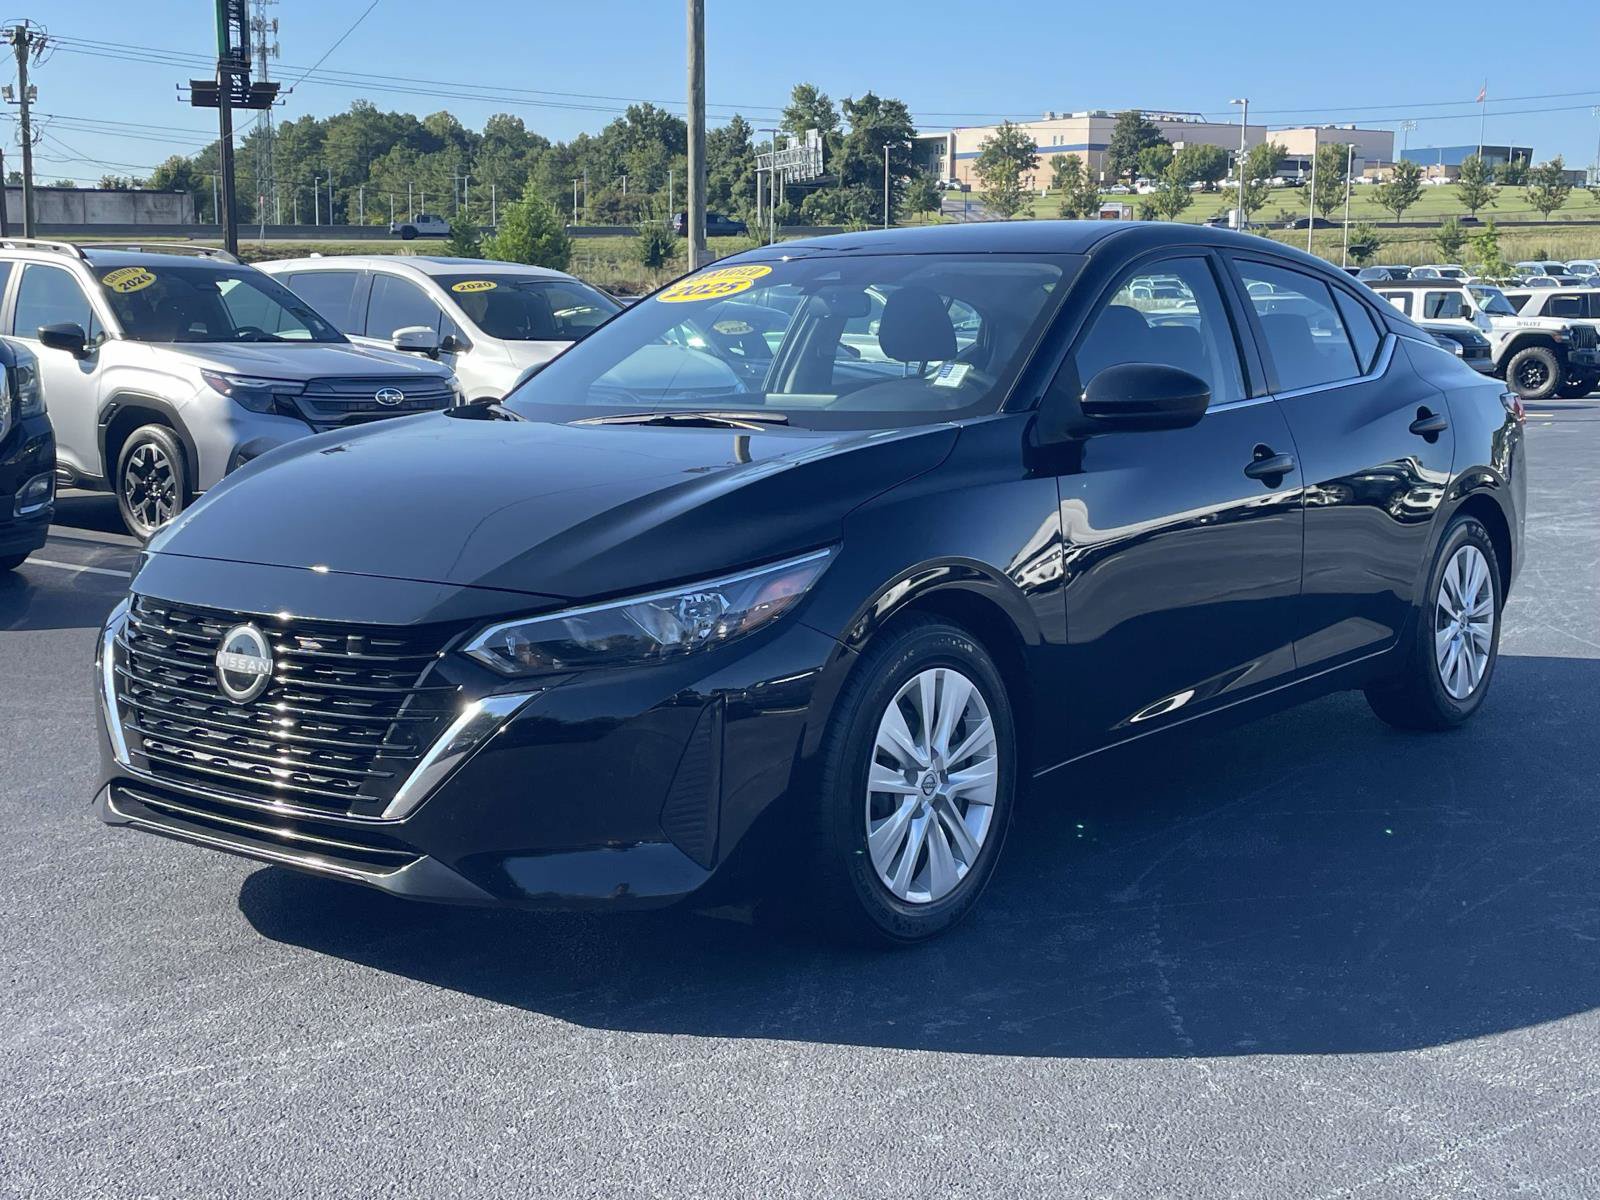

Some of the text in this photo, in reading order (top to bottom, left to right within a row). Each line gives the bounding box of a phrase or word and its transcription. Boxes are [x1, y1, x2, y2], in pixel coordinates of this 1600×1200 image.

[119, 274, 152, 290] 2026
[459, 282, 492, 290] 2020
[662, 280, 748, 299] 2025
